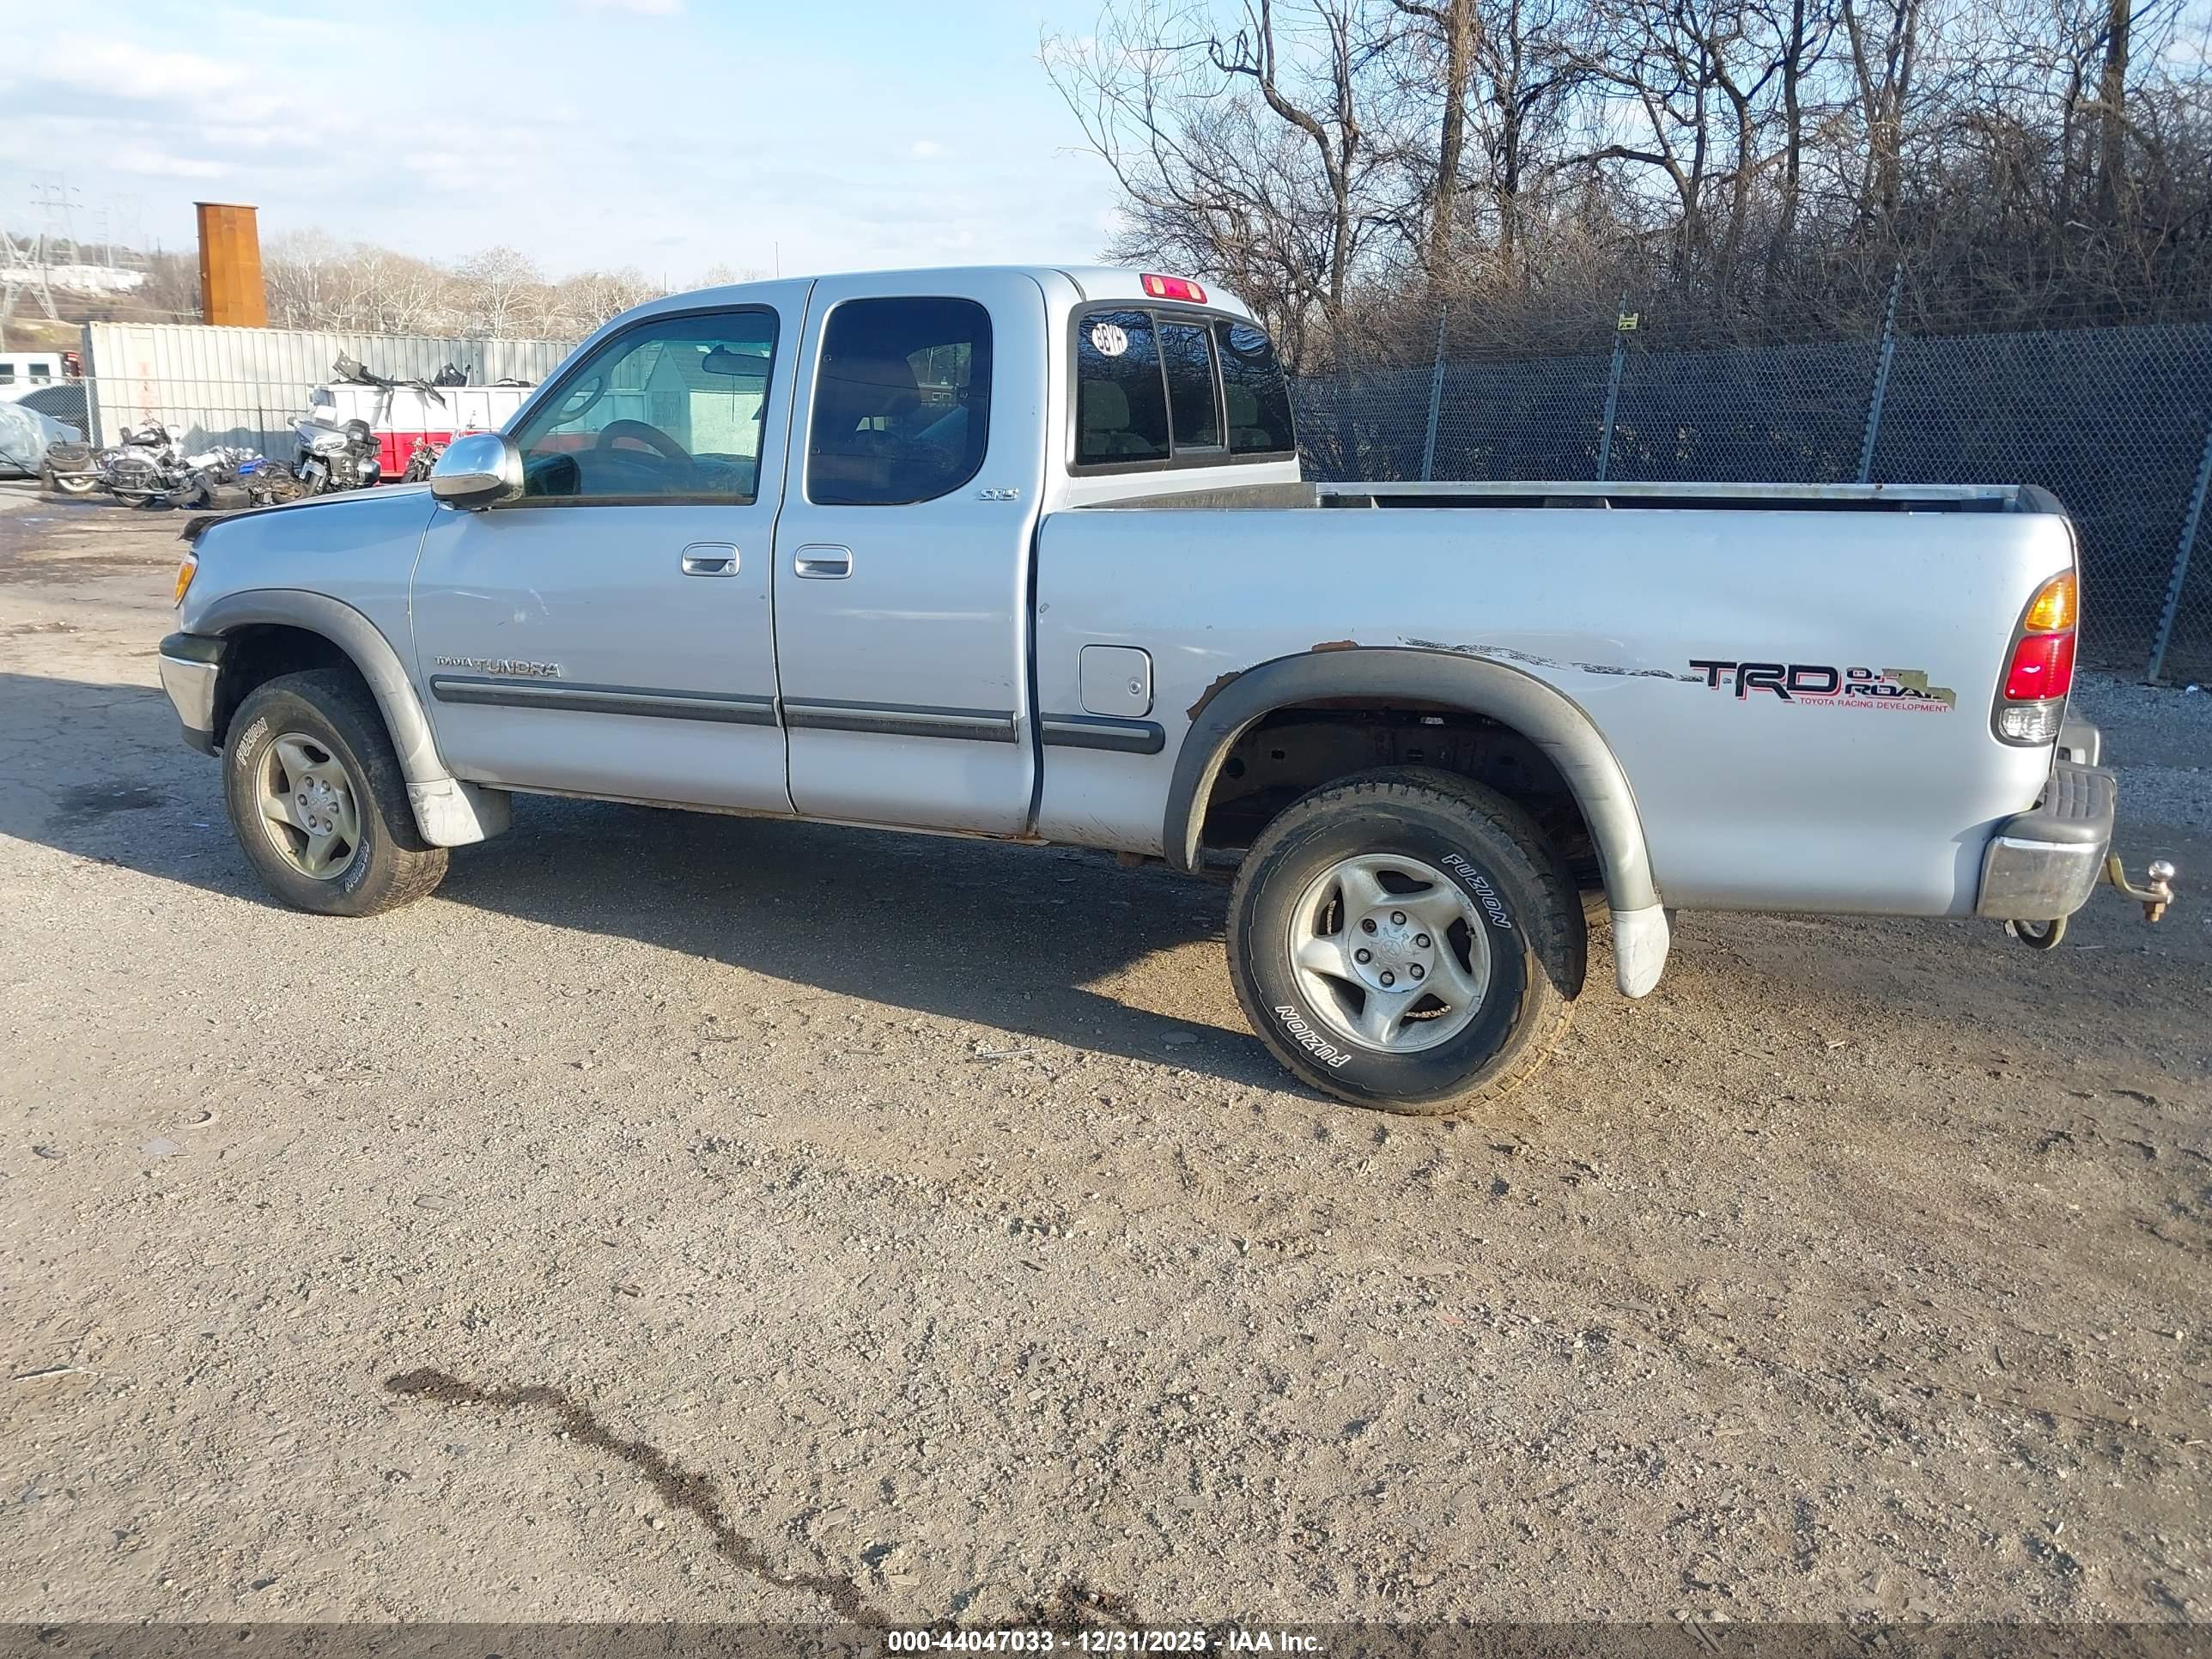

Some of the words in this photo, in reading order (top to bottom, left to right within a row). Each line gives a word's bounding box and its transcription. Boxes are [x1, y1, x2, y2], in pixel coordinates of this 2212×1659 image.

[435, 656, 472, 666] TOYOTA
[473, 658, 562, 678] TUNDRA
[1689, 659, 1841, 702] TRD
[1800, 696, 1835, 707] TOYOTA
[1838, 699, 1874, 708] RACING
[1876, 702, 1948, 713] DEVELOPMENT
[236, 716, 268, 766] FUZION
[1442, 854, 1512, 928] FUZION
[1275, 1006, 1352, 1067] FUZION
